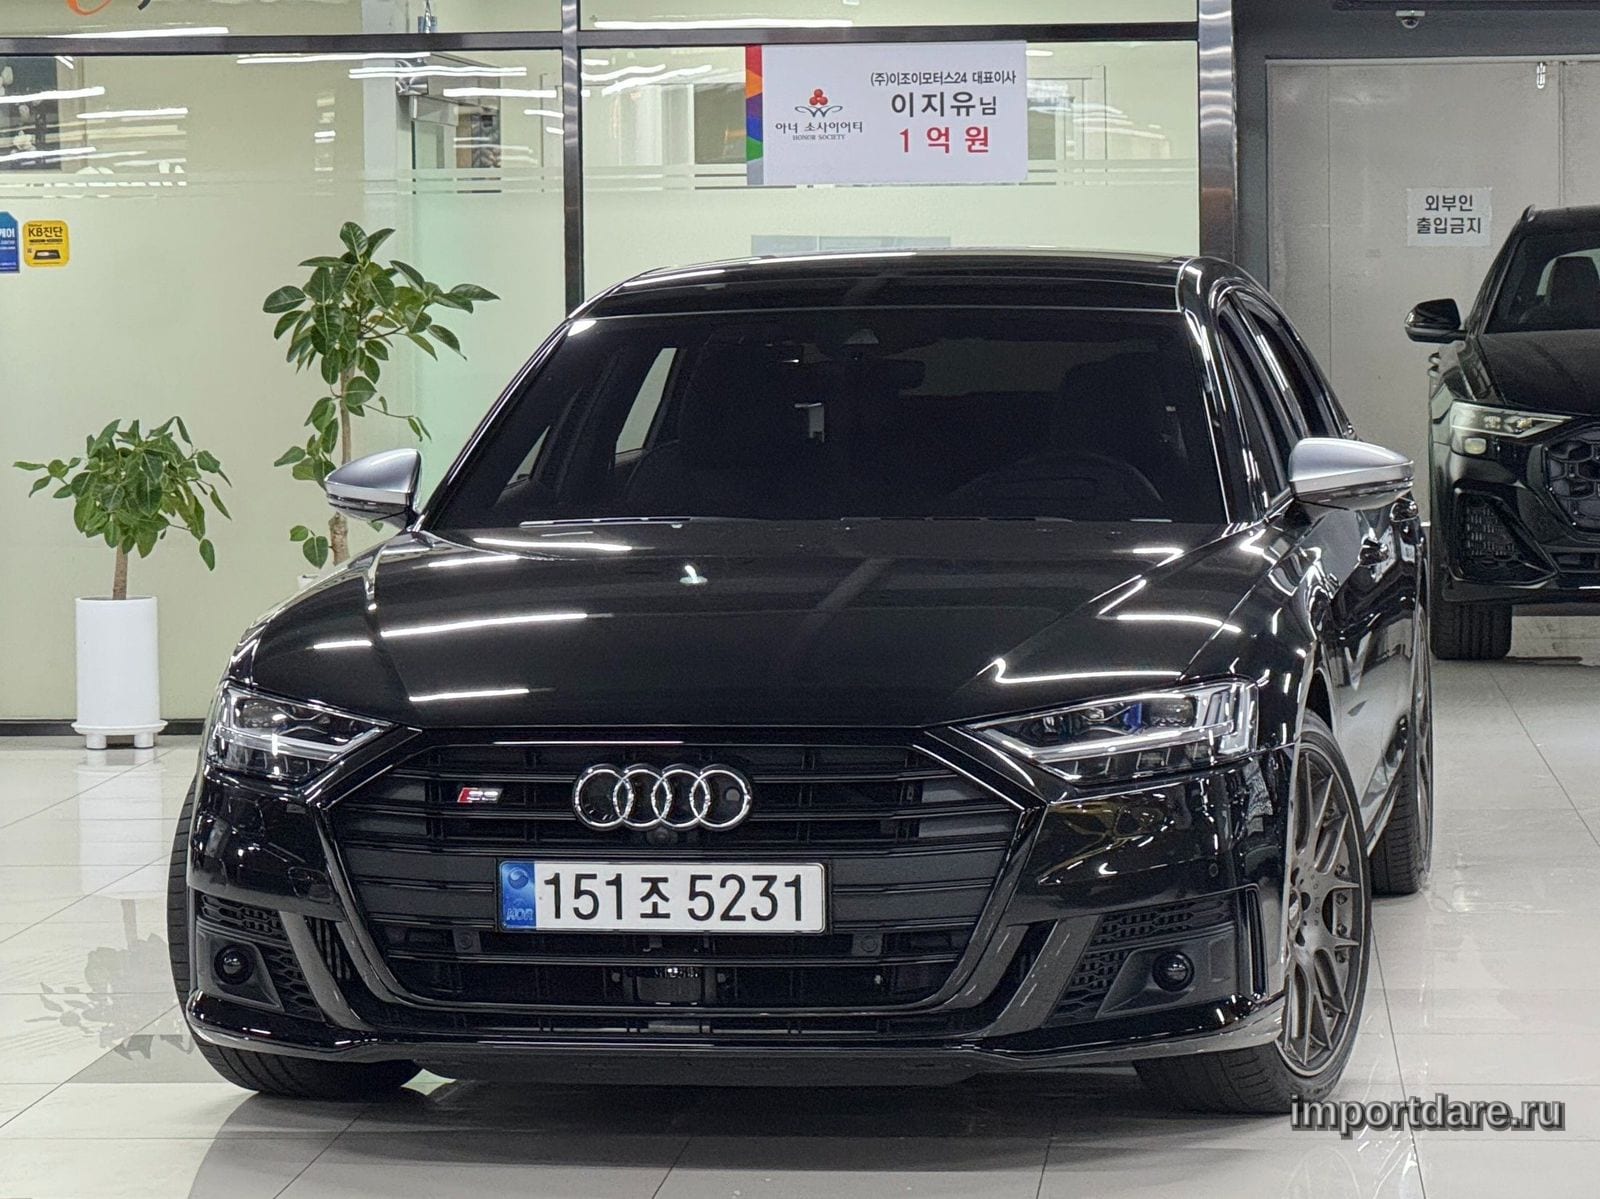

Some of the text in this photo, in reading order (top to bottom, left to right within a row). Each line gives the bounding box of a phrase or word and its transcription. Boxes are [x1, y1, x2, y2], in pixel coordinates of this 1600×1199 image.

[870, 70, 1017, 86] (주)이조이모터스24 대표이사
[891, 91, 998, 117] 이지유님
[775, 121, 863, 134] 아너 소사이어티
[899, 126, 989, 153] 1 억 원
[1425, 195, 1473, 212] 외부인
[28, 226, 63, 238] KB진단
[1417, 217, 1481, 234] 출입금지
[687, 873, 801, 921] 5231
